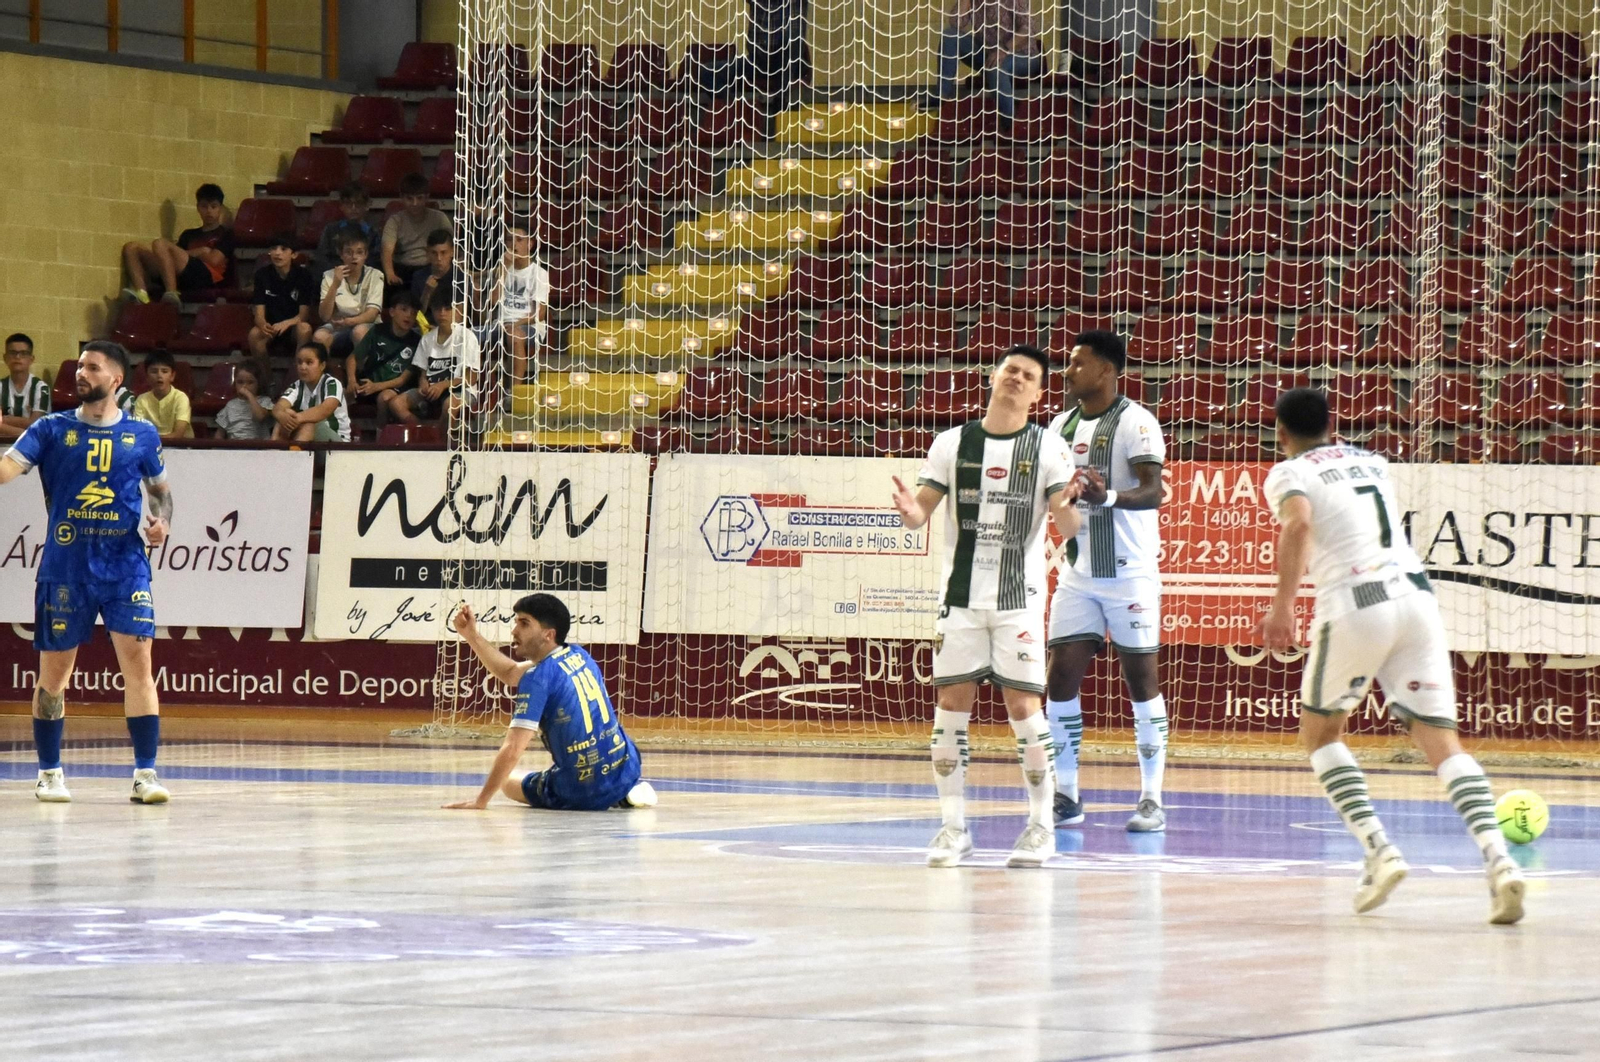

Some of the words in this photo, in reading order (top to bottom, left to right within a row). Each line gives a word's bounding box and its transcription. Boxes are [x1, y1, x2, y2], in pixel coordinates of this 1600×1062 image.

[429, 360, 452, 371] NIKE
[86, 438, 113, 473] 20
[791, 513, 901, 526] CONSTRUCCIONES
[1203, 511, 1250, 526] 14004
[1352, 484, 1392, 548] 7
[771, 531, 810, 547] Rafael
[813, 531, 852, 548] Bonilla
[856, 536, 863, 547] e
[347, 600, 368, 634] by
[369, 597, 436, 640] José
[865, 641, 902, 682] DE
[292, 668, 330, 693] de
[339, 670, 473, 704] Deportes
[571, 667, 610, 734] 14
[1533, 697, 1574, 726] de
